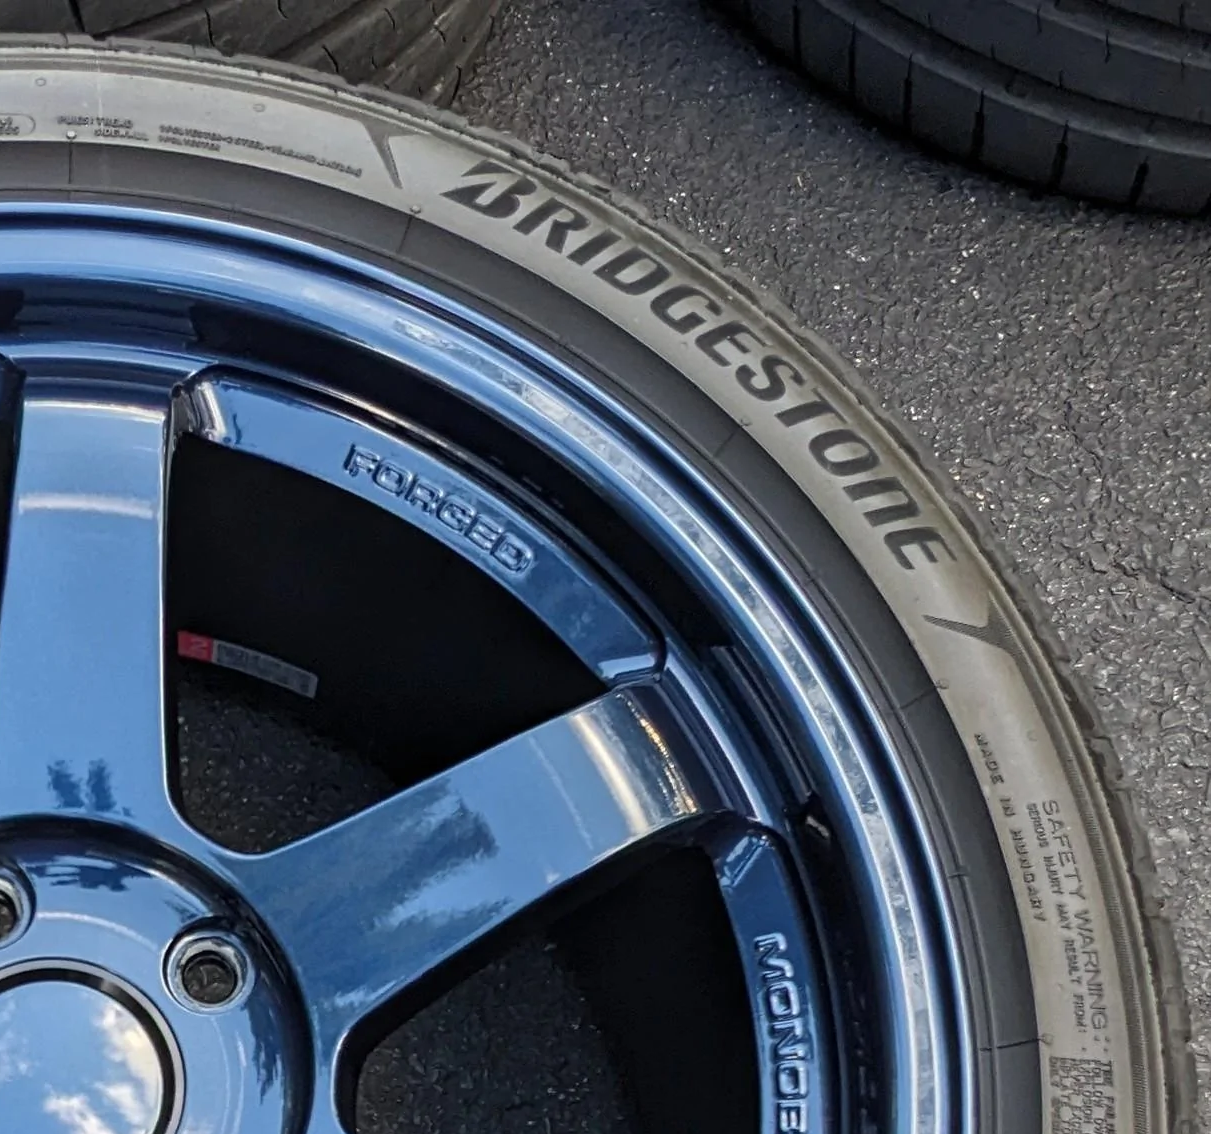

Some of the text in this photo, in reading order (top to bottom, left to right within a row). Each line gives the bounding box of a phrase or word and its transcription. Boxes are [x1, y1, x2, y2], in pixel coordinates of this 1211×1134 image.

[439, 160, 957, 570] BRIDGESTONE
[343, 444, 535, 576] FORGED
[975, 733, 1046, 922] MADE IN HUNGARY
[1042, 800, 1086, 900] SAFETY
